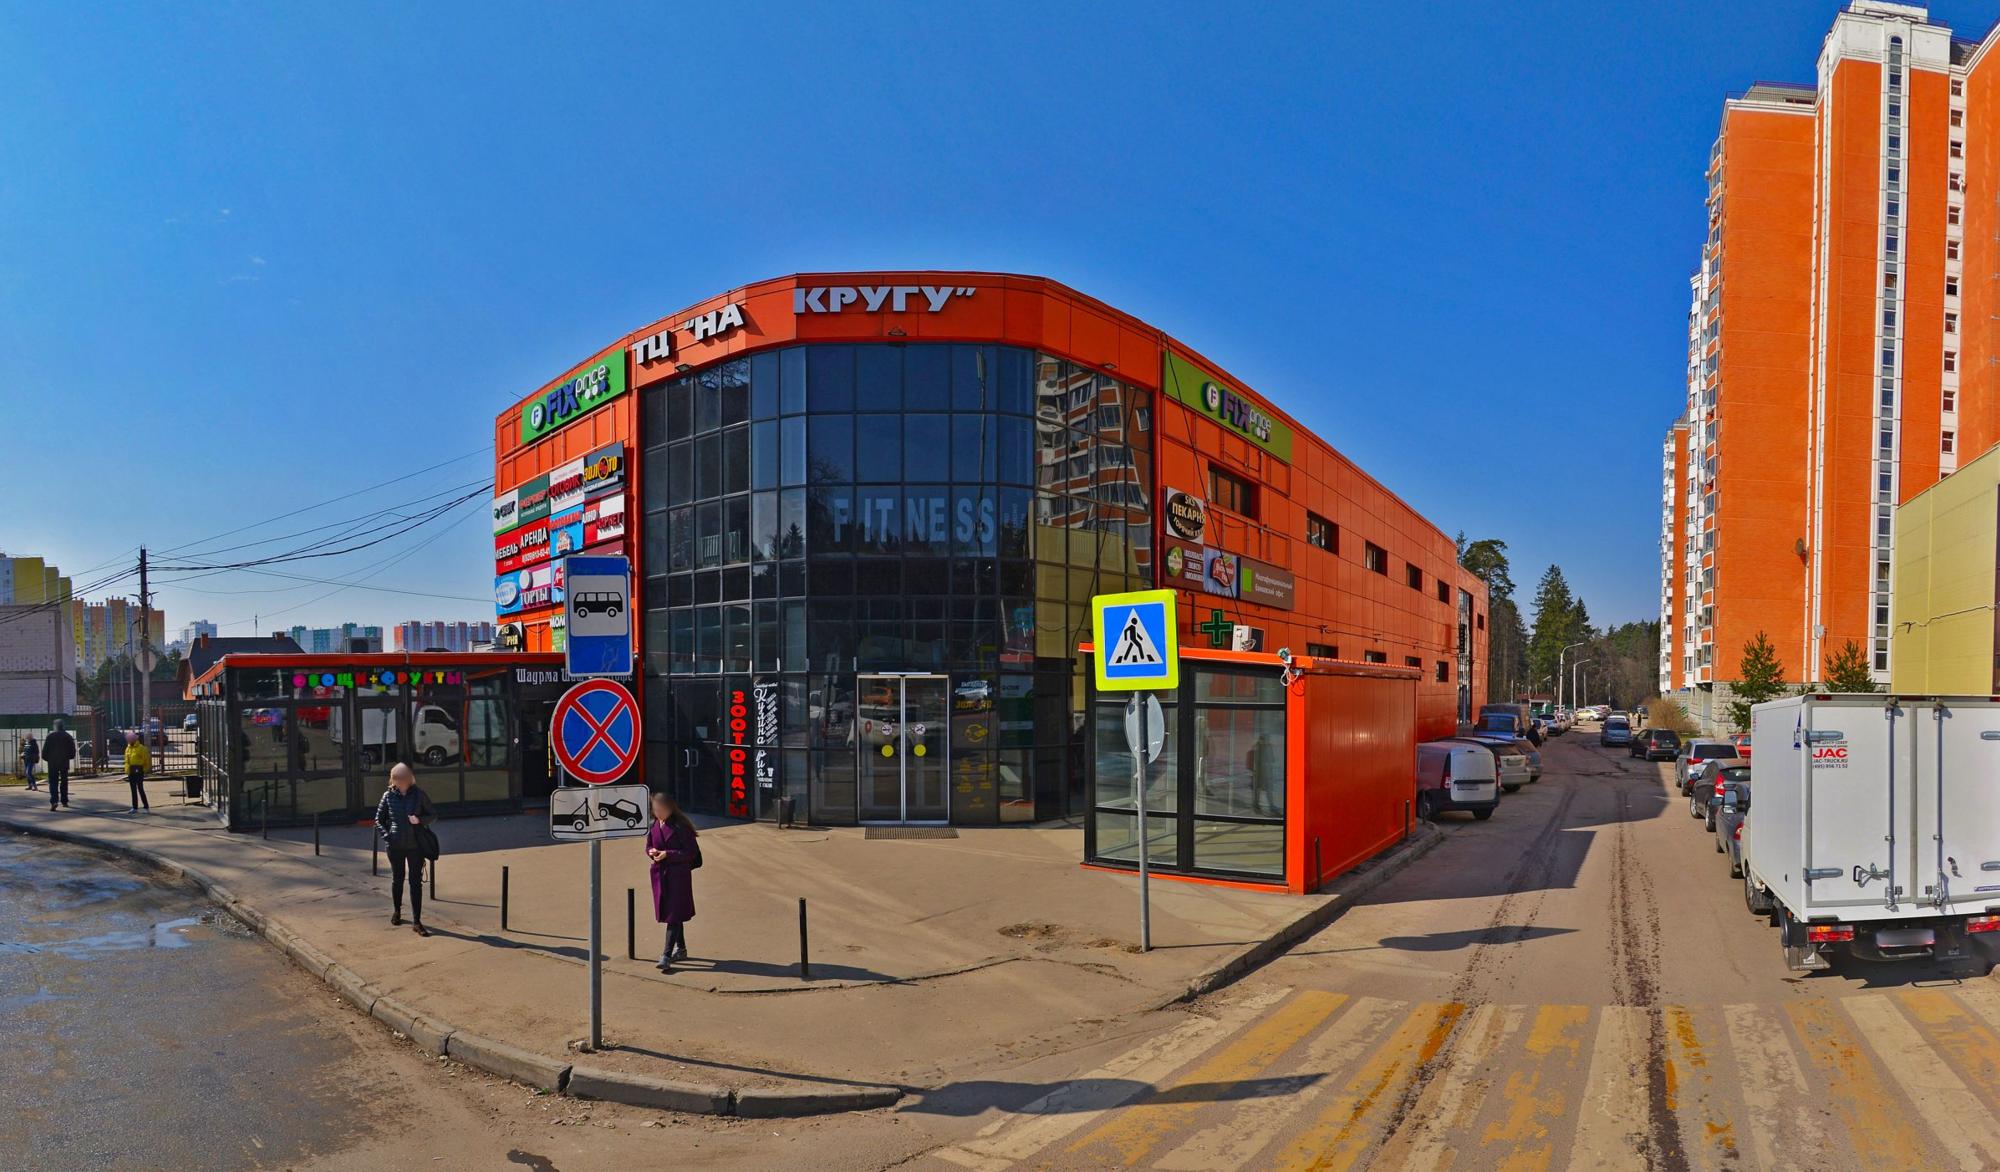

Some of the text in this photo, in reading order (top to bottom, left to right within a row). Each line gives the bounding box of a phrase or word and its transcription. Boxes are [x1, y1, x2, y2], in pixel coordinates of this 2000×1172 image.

[633, 331, 671, 364] ТЦ
[575, 364, 607, 398] price
[834, 498, 994, 543] FITNESS
[520, 527, 548, 549] АРЕНДА
[495, 544, 519, 560] МЕБЕЛЬ
[519, 587, 548, 606] ТОРТЫ
[516, 668, 558, 685] Шаурма
[729, 691, 748, 816] ЗООТОВАРЫ
[1812, 748, 1848, 758] JAC
